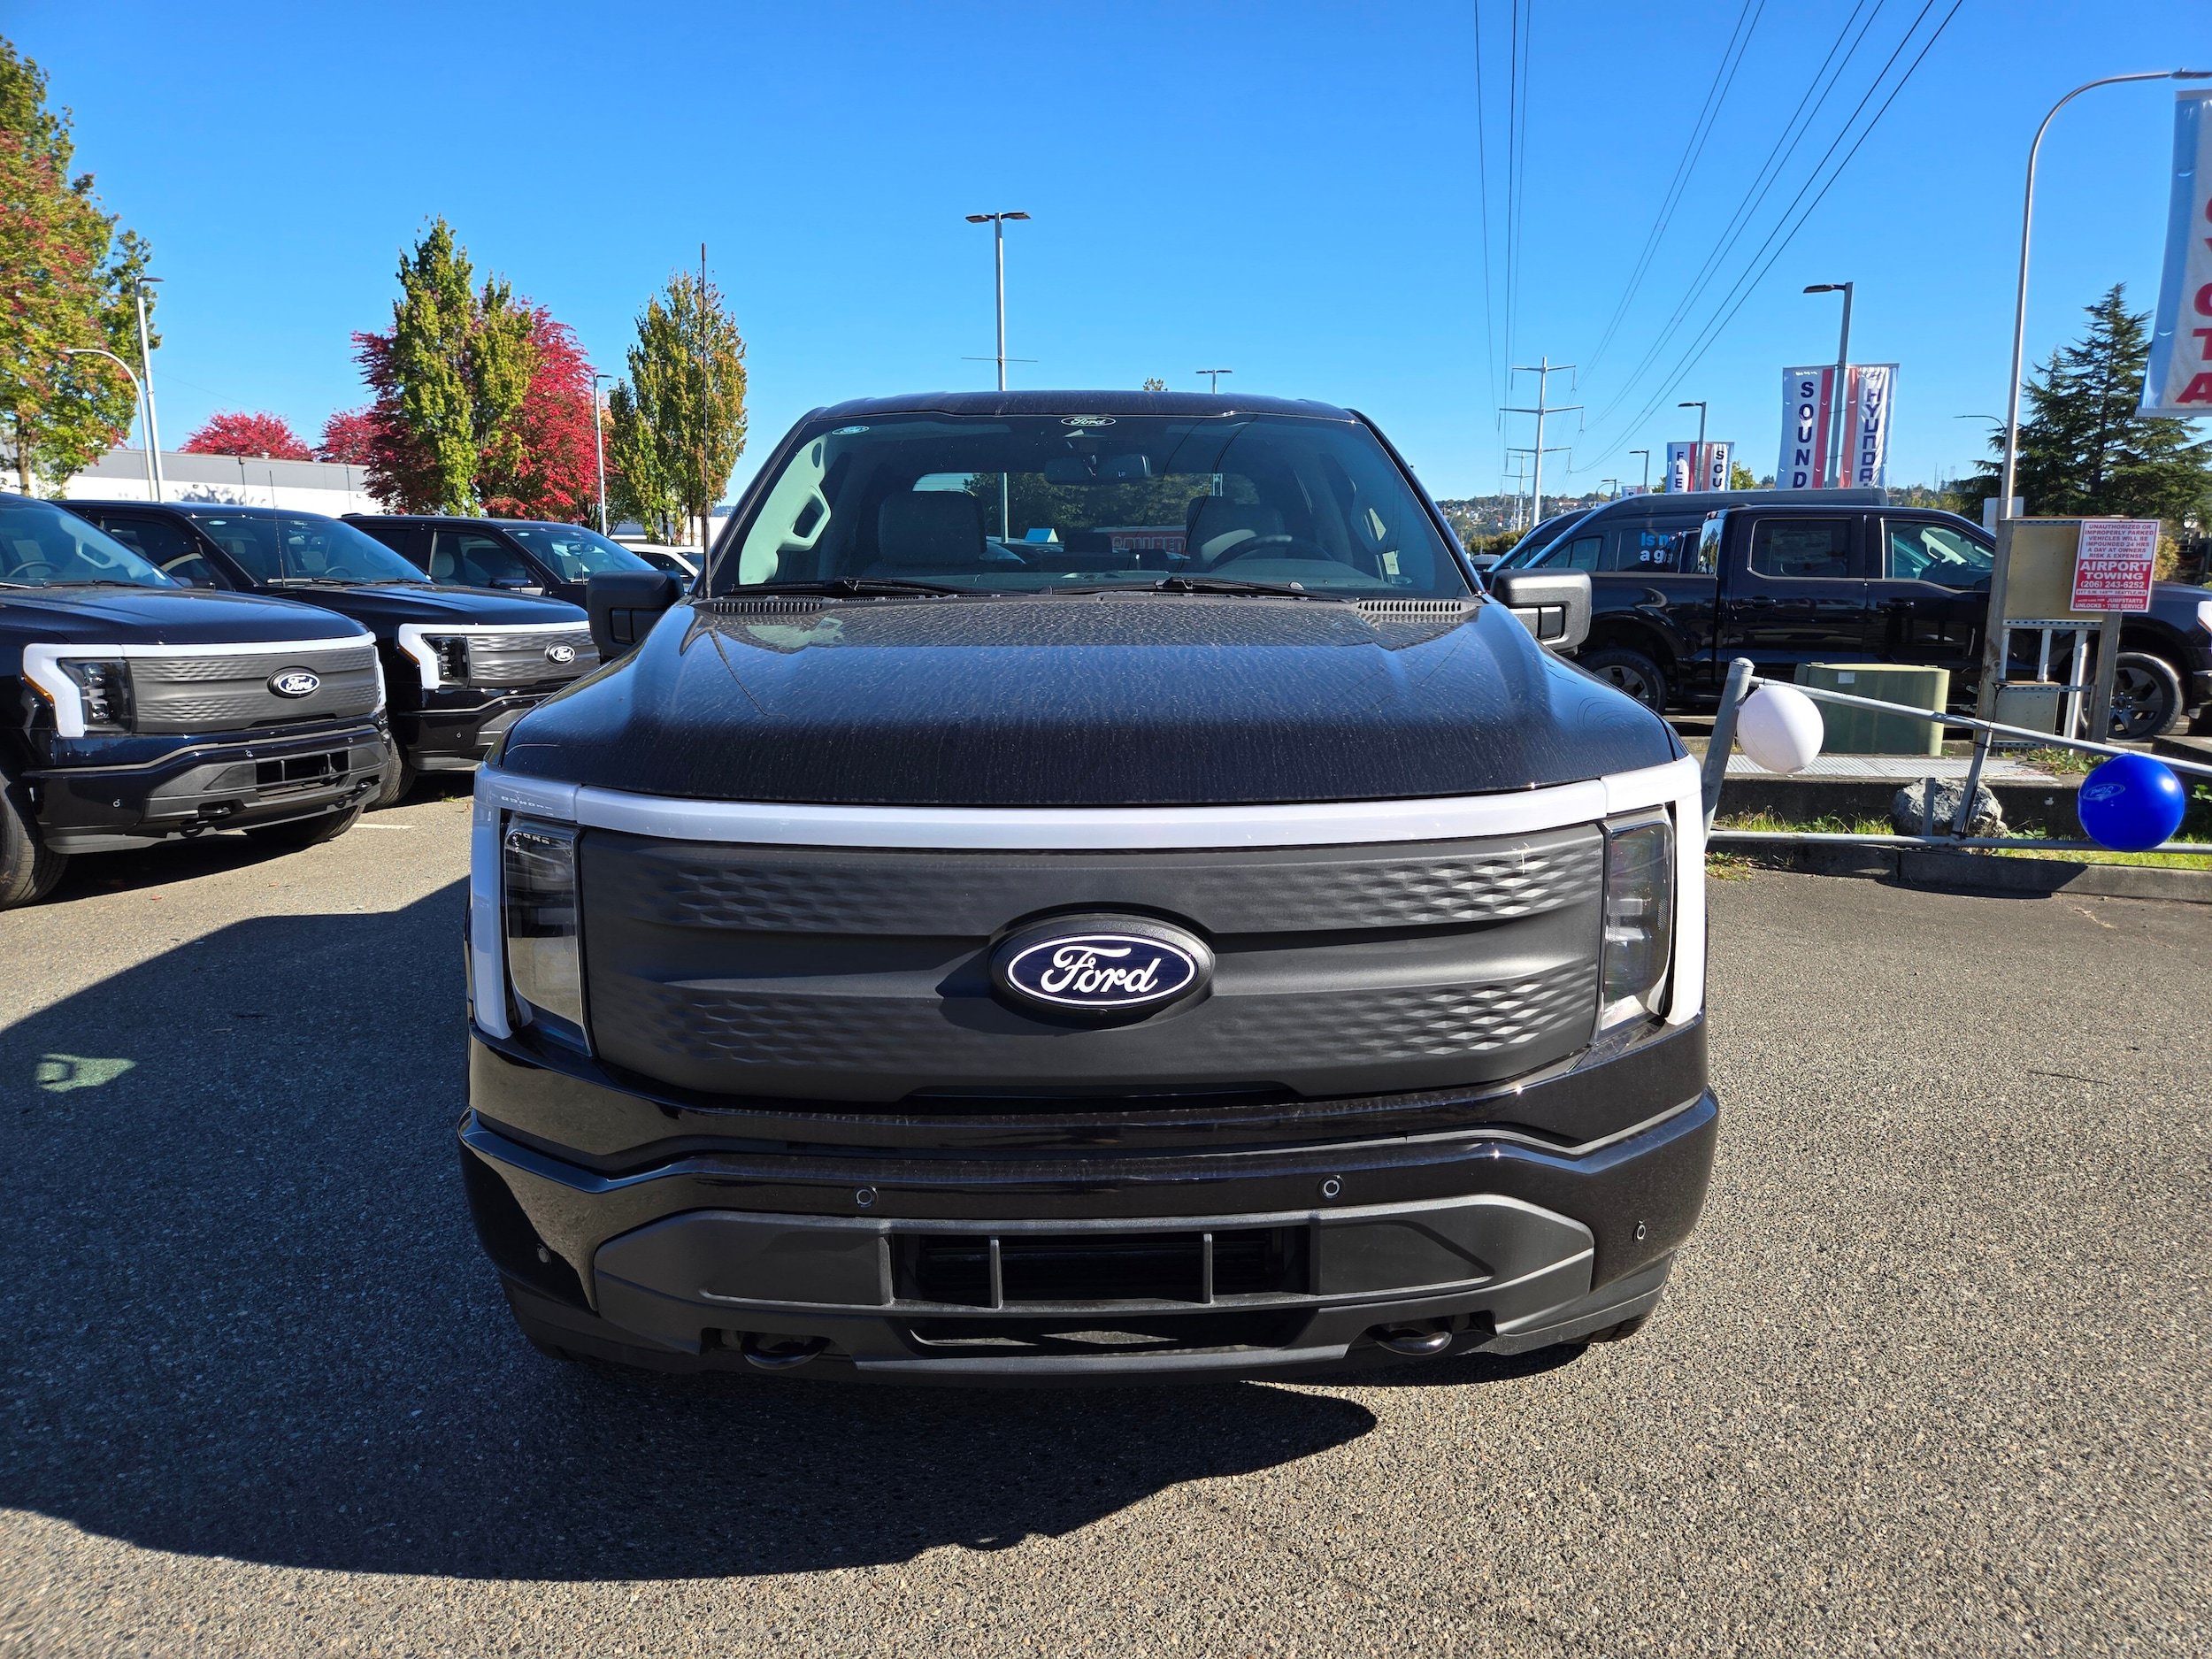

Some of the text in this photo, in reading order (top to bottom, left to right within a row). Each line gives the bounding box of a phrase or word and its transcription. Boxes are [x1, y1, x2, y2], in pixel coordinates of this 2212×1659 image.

[1792, 381, 1815, 488] SOUND
[1859, 388, 1881, 487] HYUNDA
[1712, 450, 1724, 488] SOU
[2080, 561, 2150, 572] AIRPORT
[2085, 572, 2144, 580] TOWING
[286, 676, 313, 690] Ford
[1041, 945, 1161, 994] Ford
